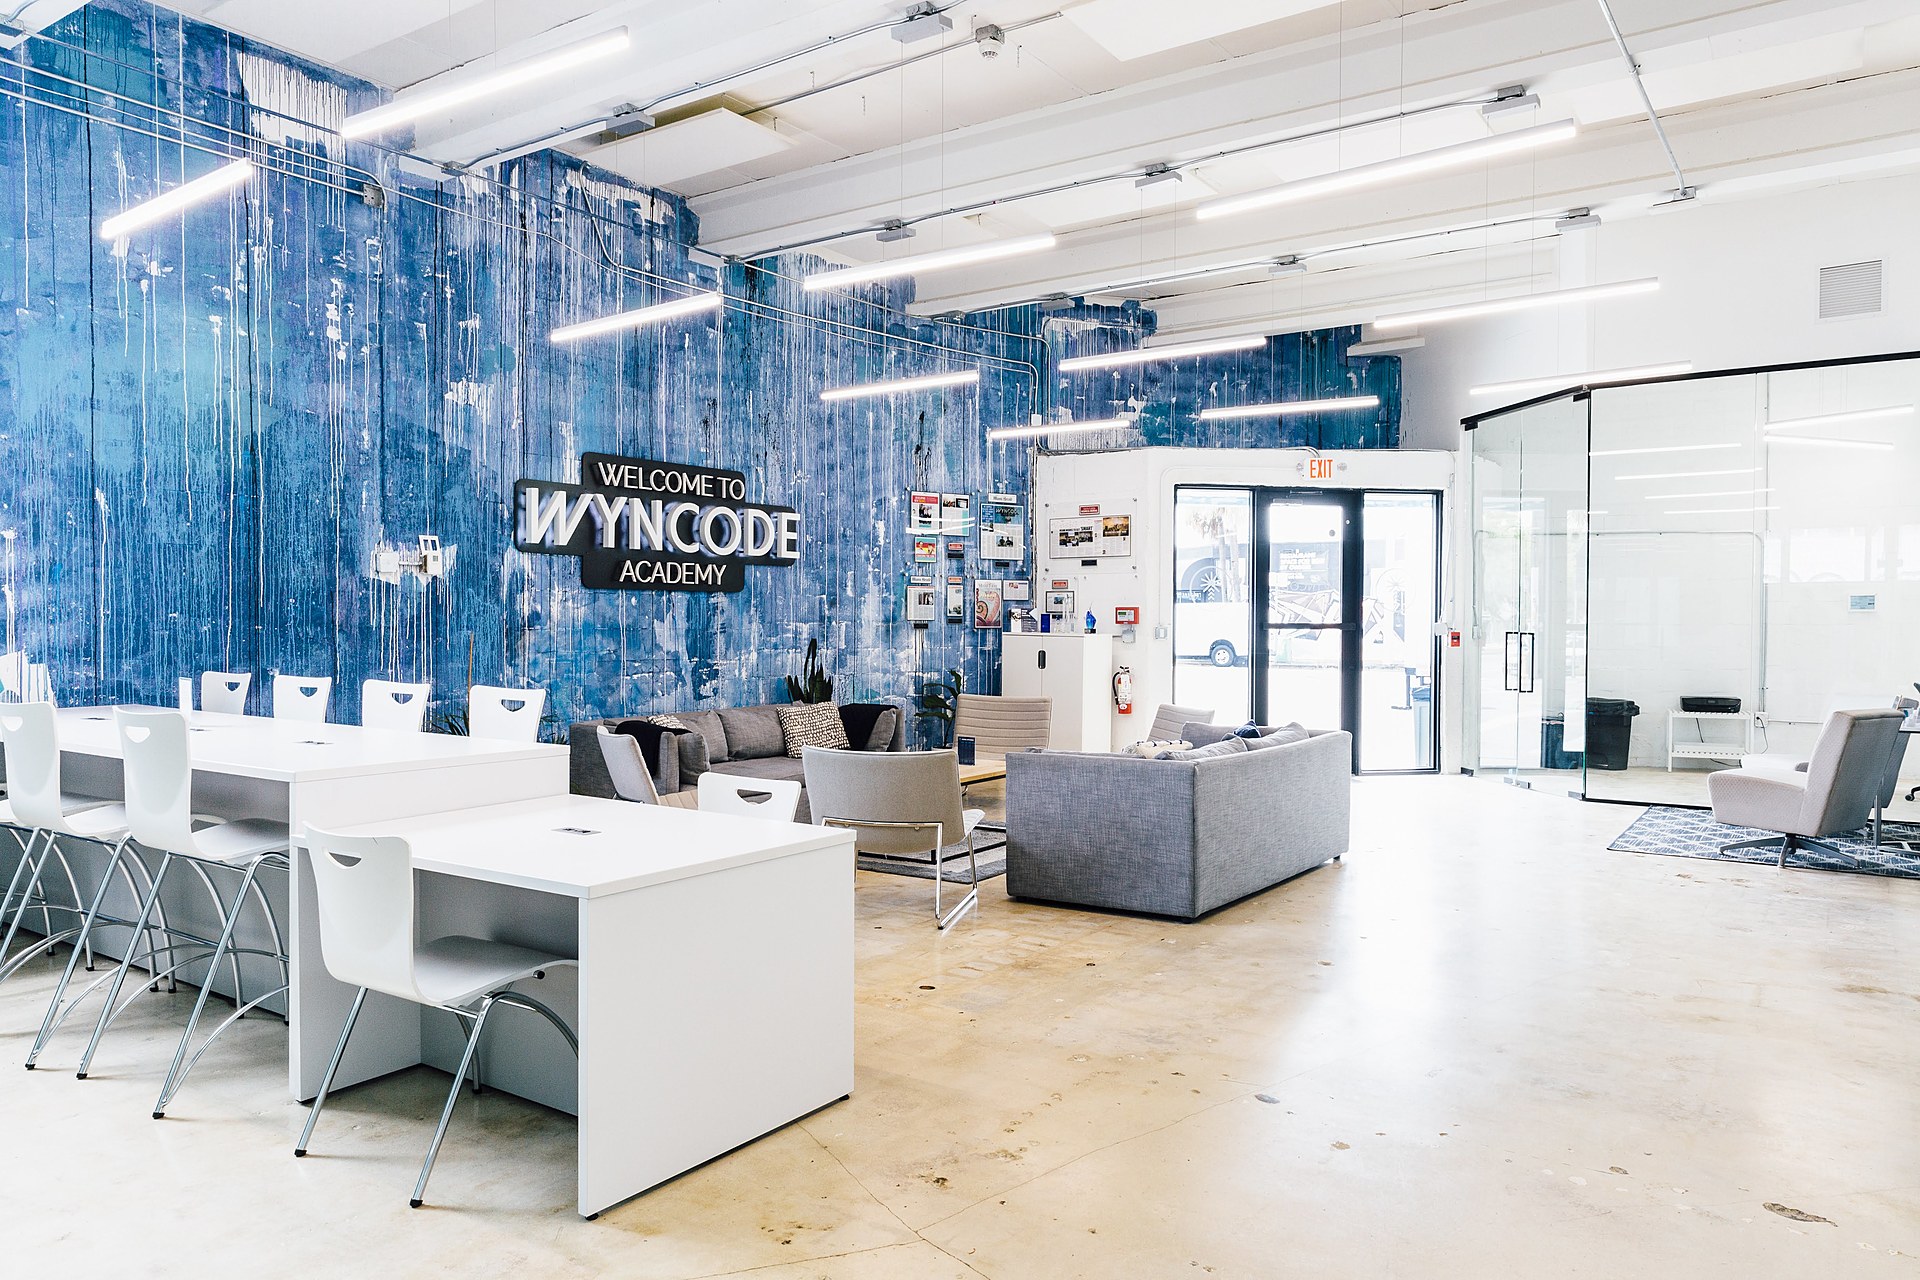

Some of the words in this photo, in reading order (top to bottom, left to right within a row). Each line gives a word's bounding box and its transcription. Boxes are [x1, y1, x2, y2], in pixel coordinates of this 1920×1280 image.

[597, 461, 714, 497] WELCOME
[716, 476, 746, 500] TO
[1309, 459, 1333, 479] EXIT
[525, 487, 801, 560] WYNCODE
[619, 559, 727, 586] ACADEMY
